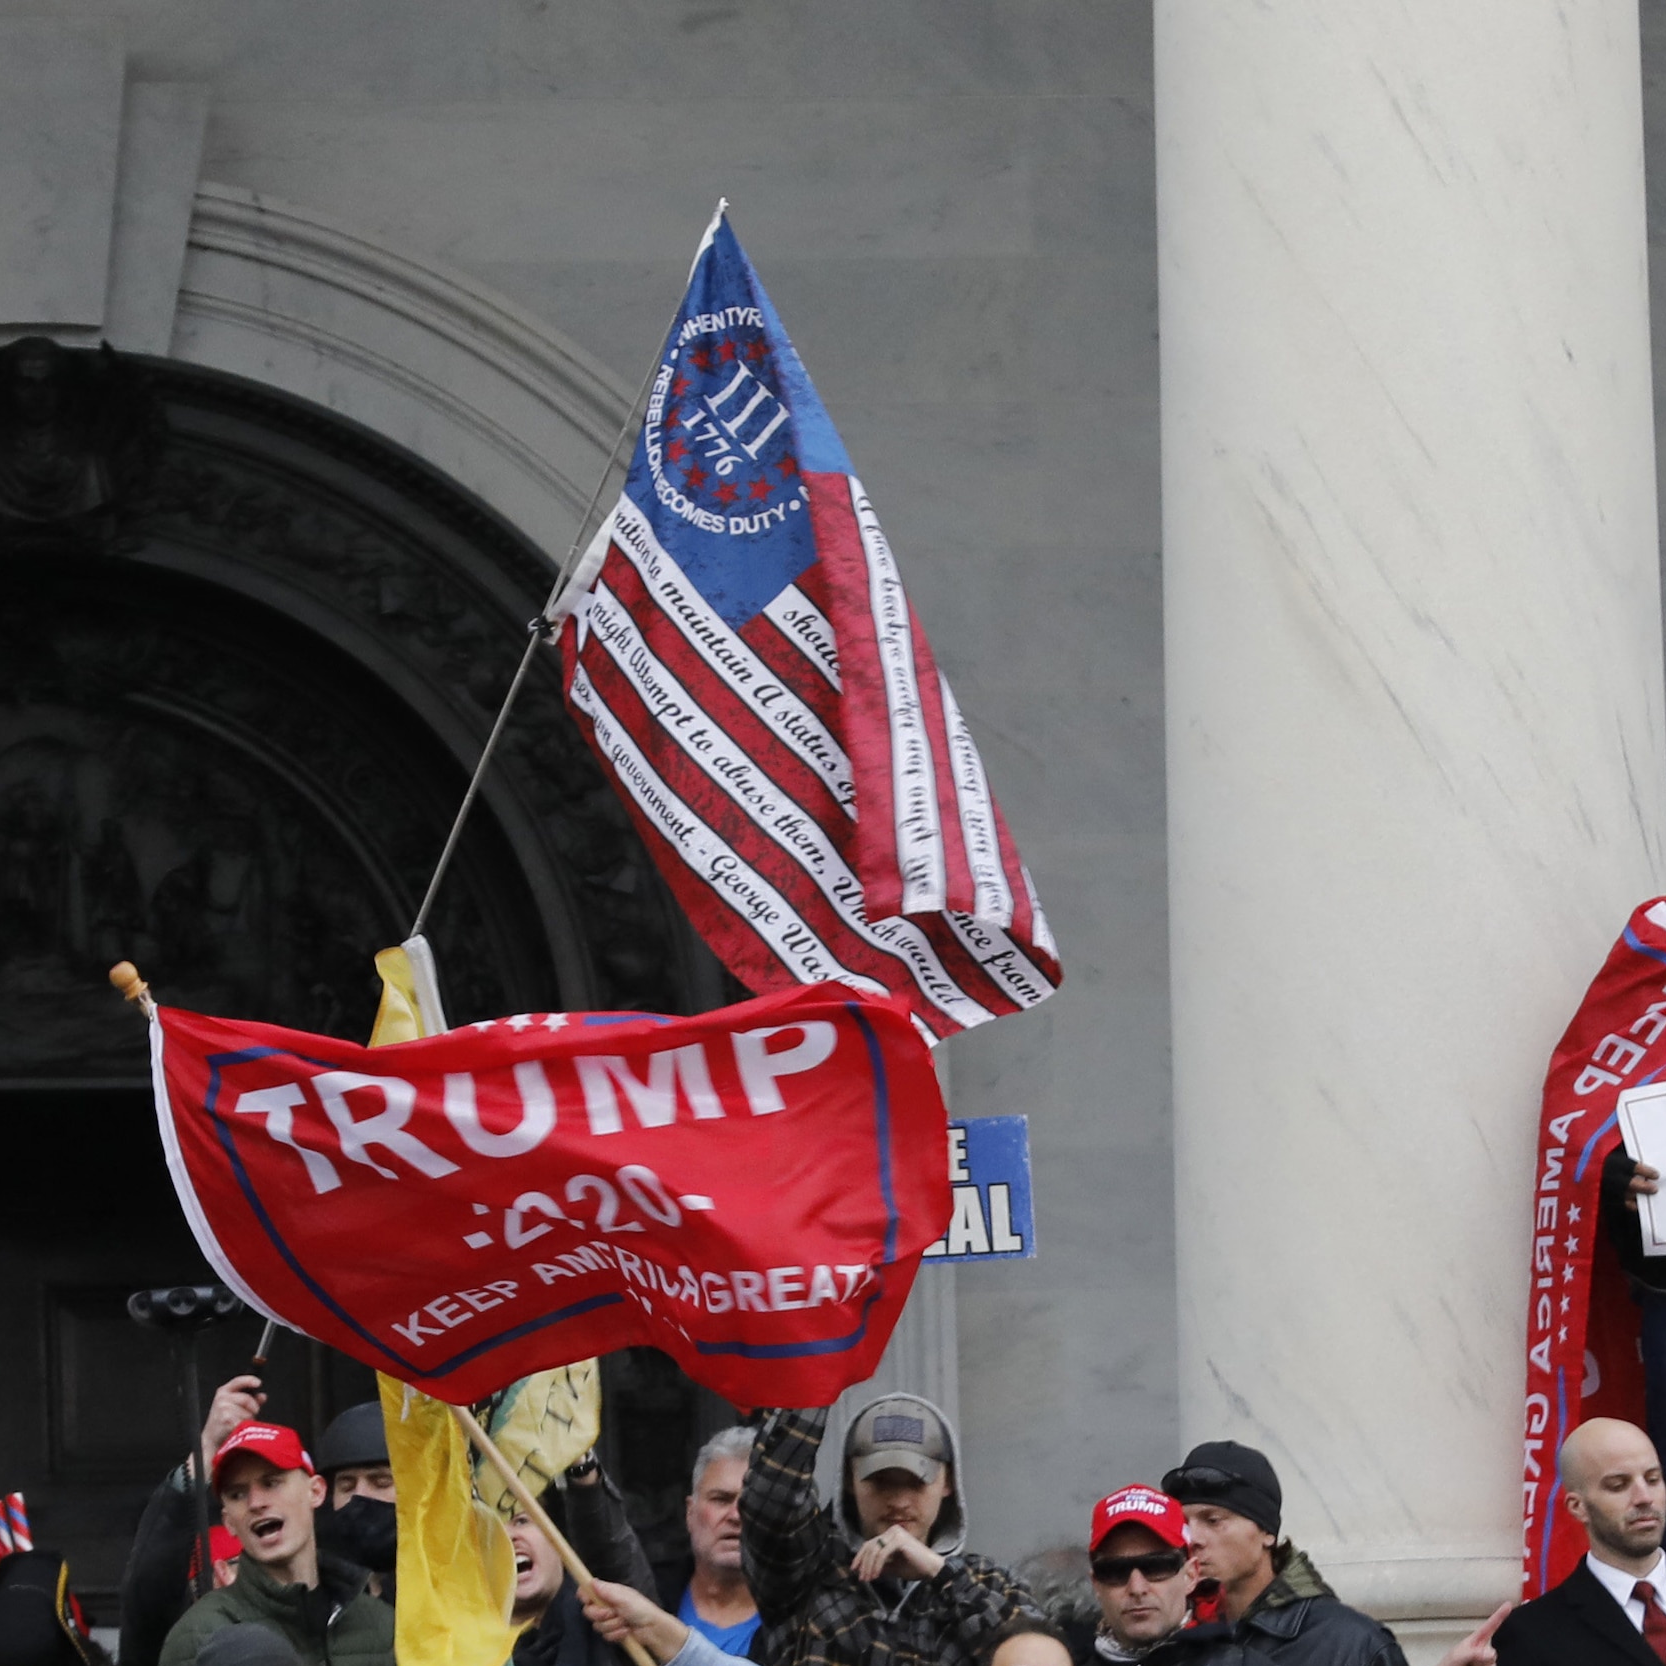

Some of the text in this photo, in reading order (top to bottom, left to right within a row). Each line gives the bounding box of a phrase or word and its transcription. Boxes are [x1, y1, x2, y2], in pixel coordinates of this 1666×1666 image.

[681, 408, 744, 476] 1776
[729, 502, 787, 536] DUTY
[659, 580, 754, 685] maintain
[774, 707, 837, 773] status
[712, 755, 776, 817] abuse
[710, 853, 779, 926] George
[981, 949, 1042, 1003] from
[234, 1018, 839, 1196] TRUMP
[922, 1183, 1023, 1257] AL
[391, 1279, 520, 1348] KEEP
[1106, 1499, 1167, 1517] TRUMP
